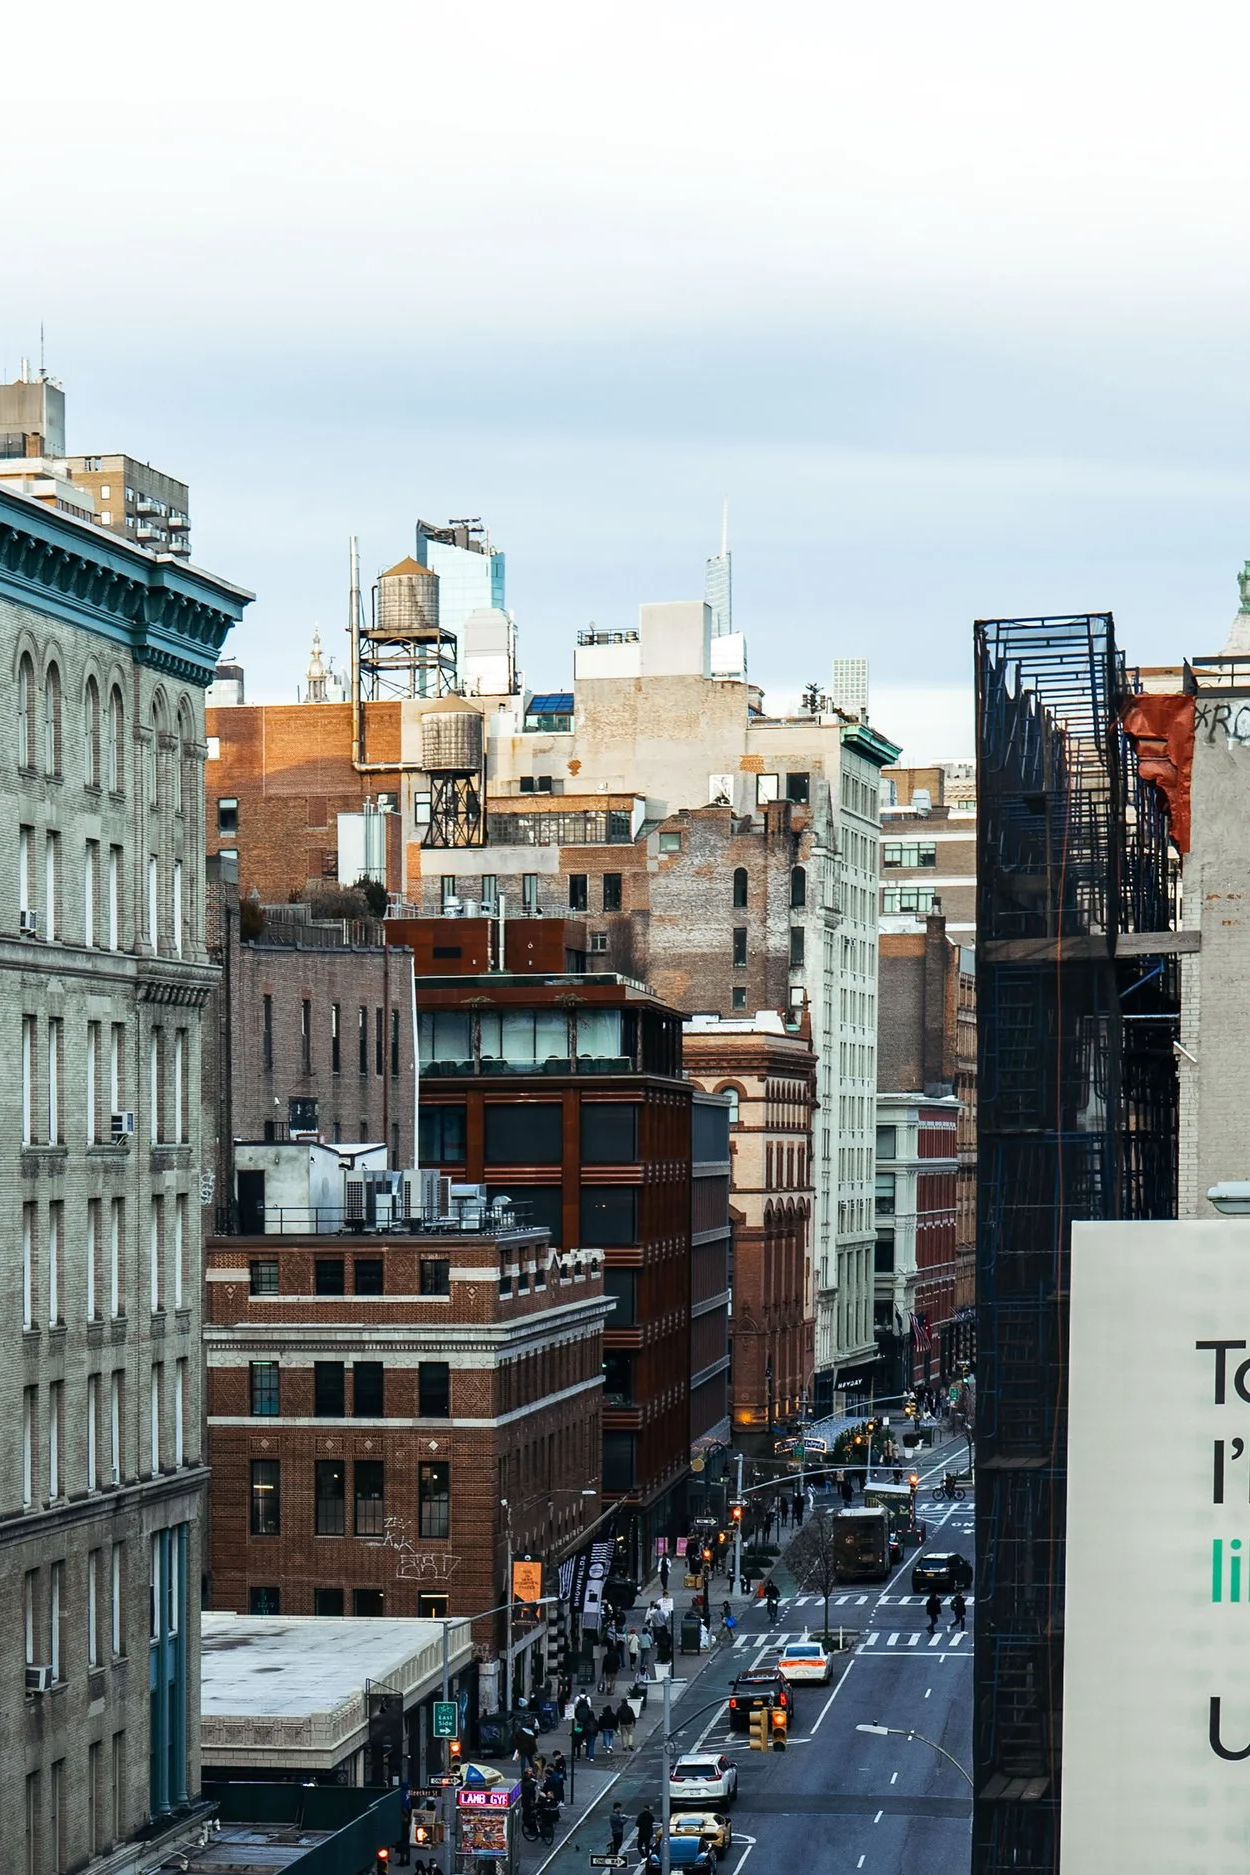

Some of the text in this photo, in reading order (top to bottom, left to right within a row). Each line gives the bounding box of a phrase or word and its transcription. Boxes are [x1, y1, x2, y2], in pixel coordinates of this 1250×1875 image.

[837, 1378, 863, 1389] HEYDAY
[573, 1555, 587, 1607] SHOWFIELDS
[461, 1793, 486, 1804] LAMB
